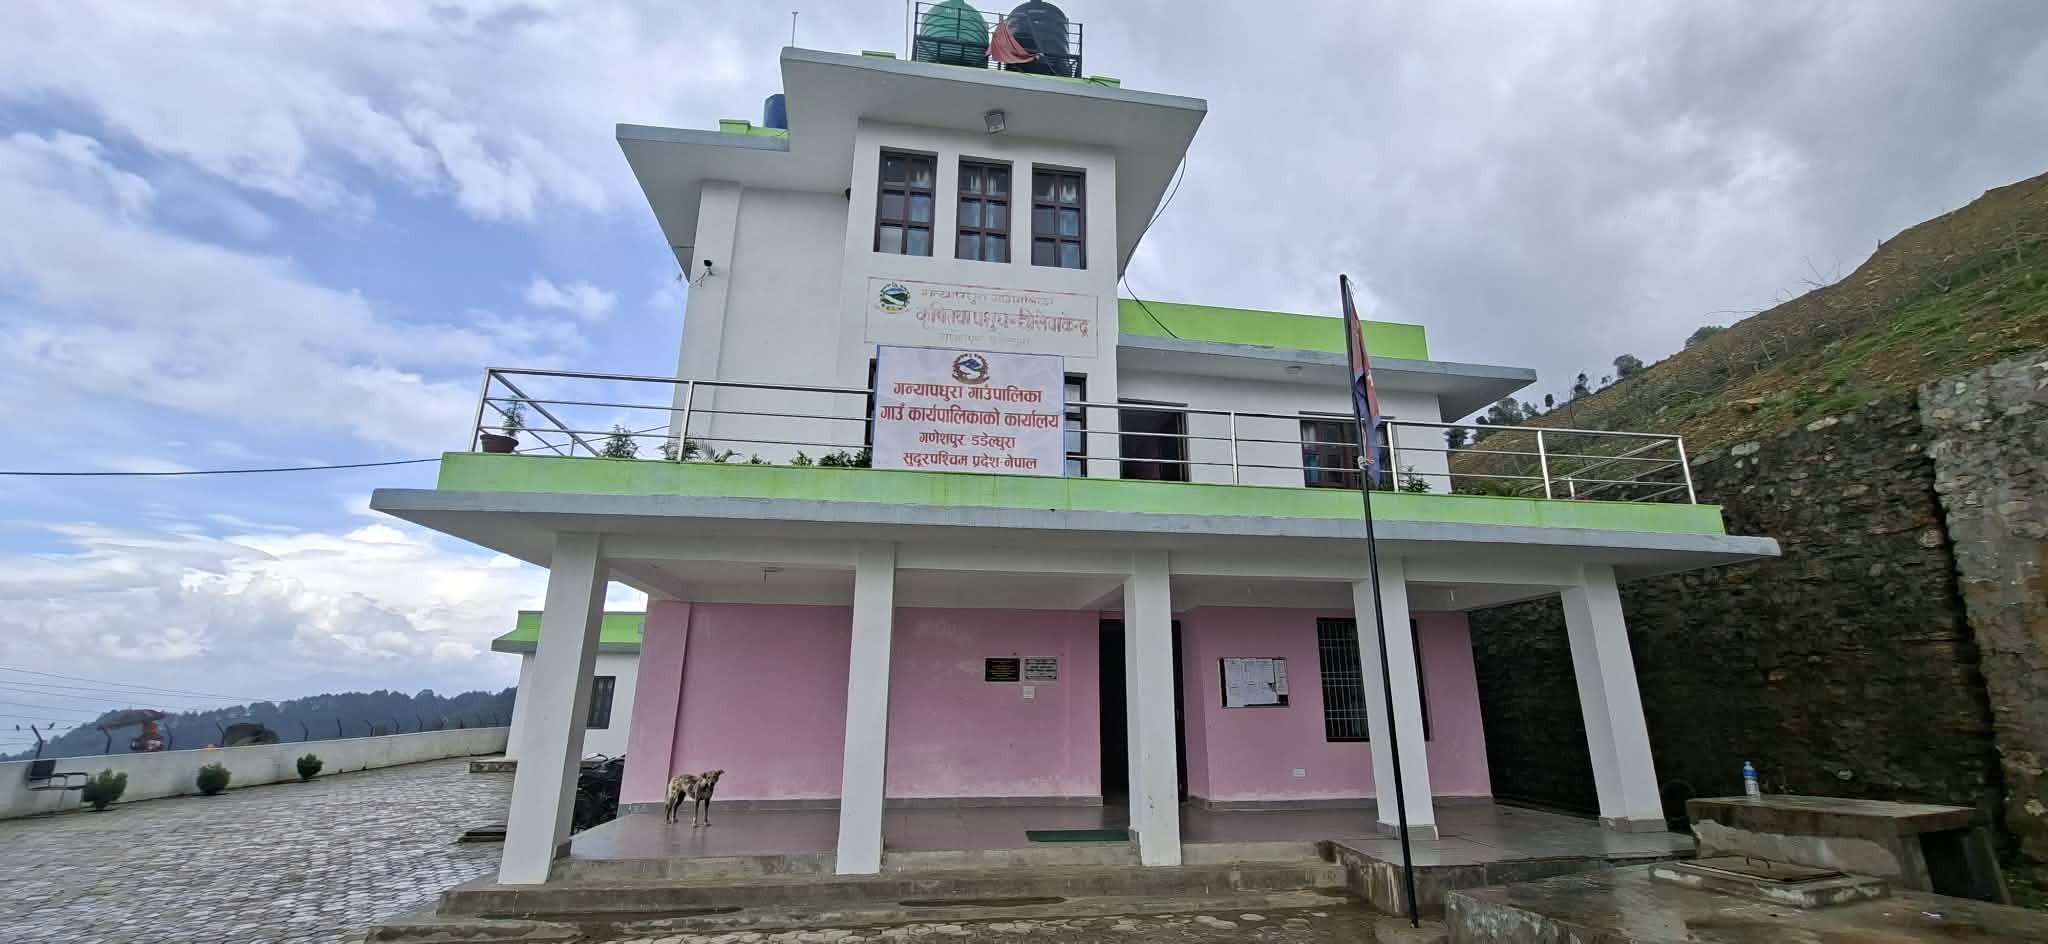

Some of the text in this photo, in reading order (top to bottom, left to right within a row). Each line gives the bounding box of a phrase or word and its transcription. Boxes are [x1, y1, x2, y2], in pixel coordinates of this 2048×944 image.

[894, 382, 963, 401] गन्यापधुरा
[908, 404, 1001, 426] कार्यपालिकाको
[1004, 410, 1061, 428] कार्यालय
[903, 451, 968, 467] सुदूरपश्चिम
